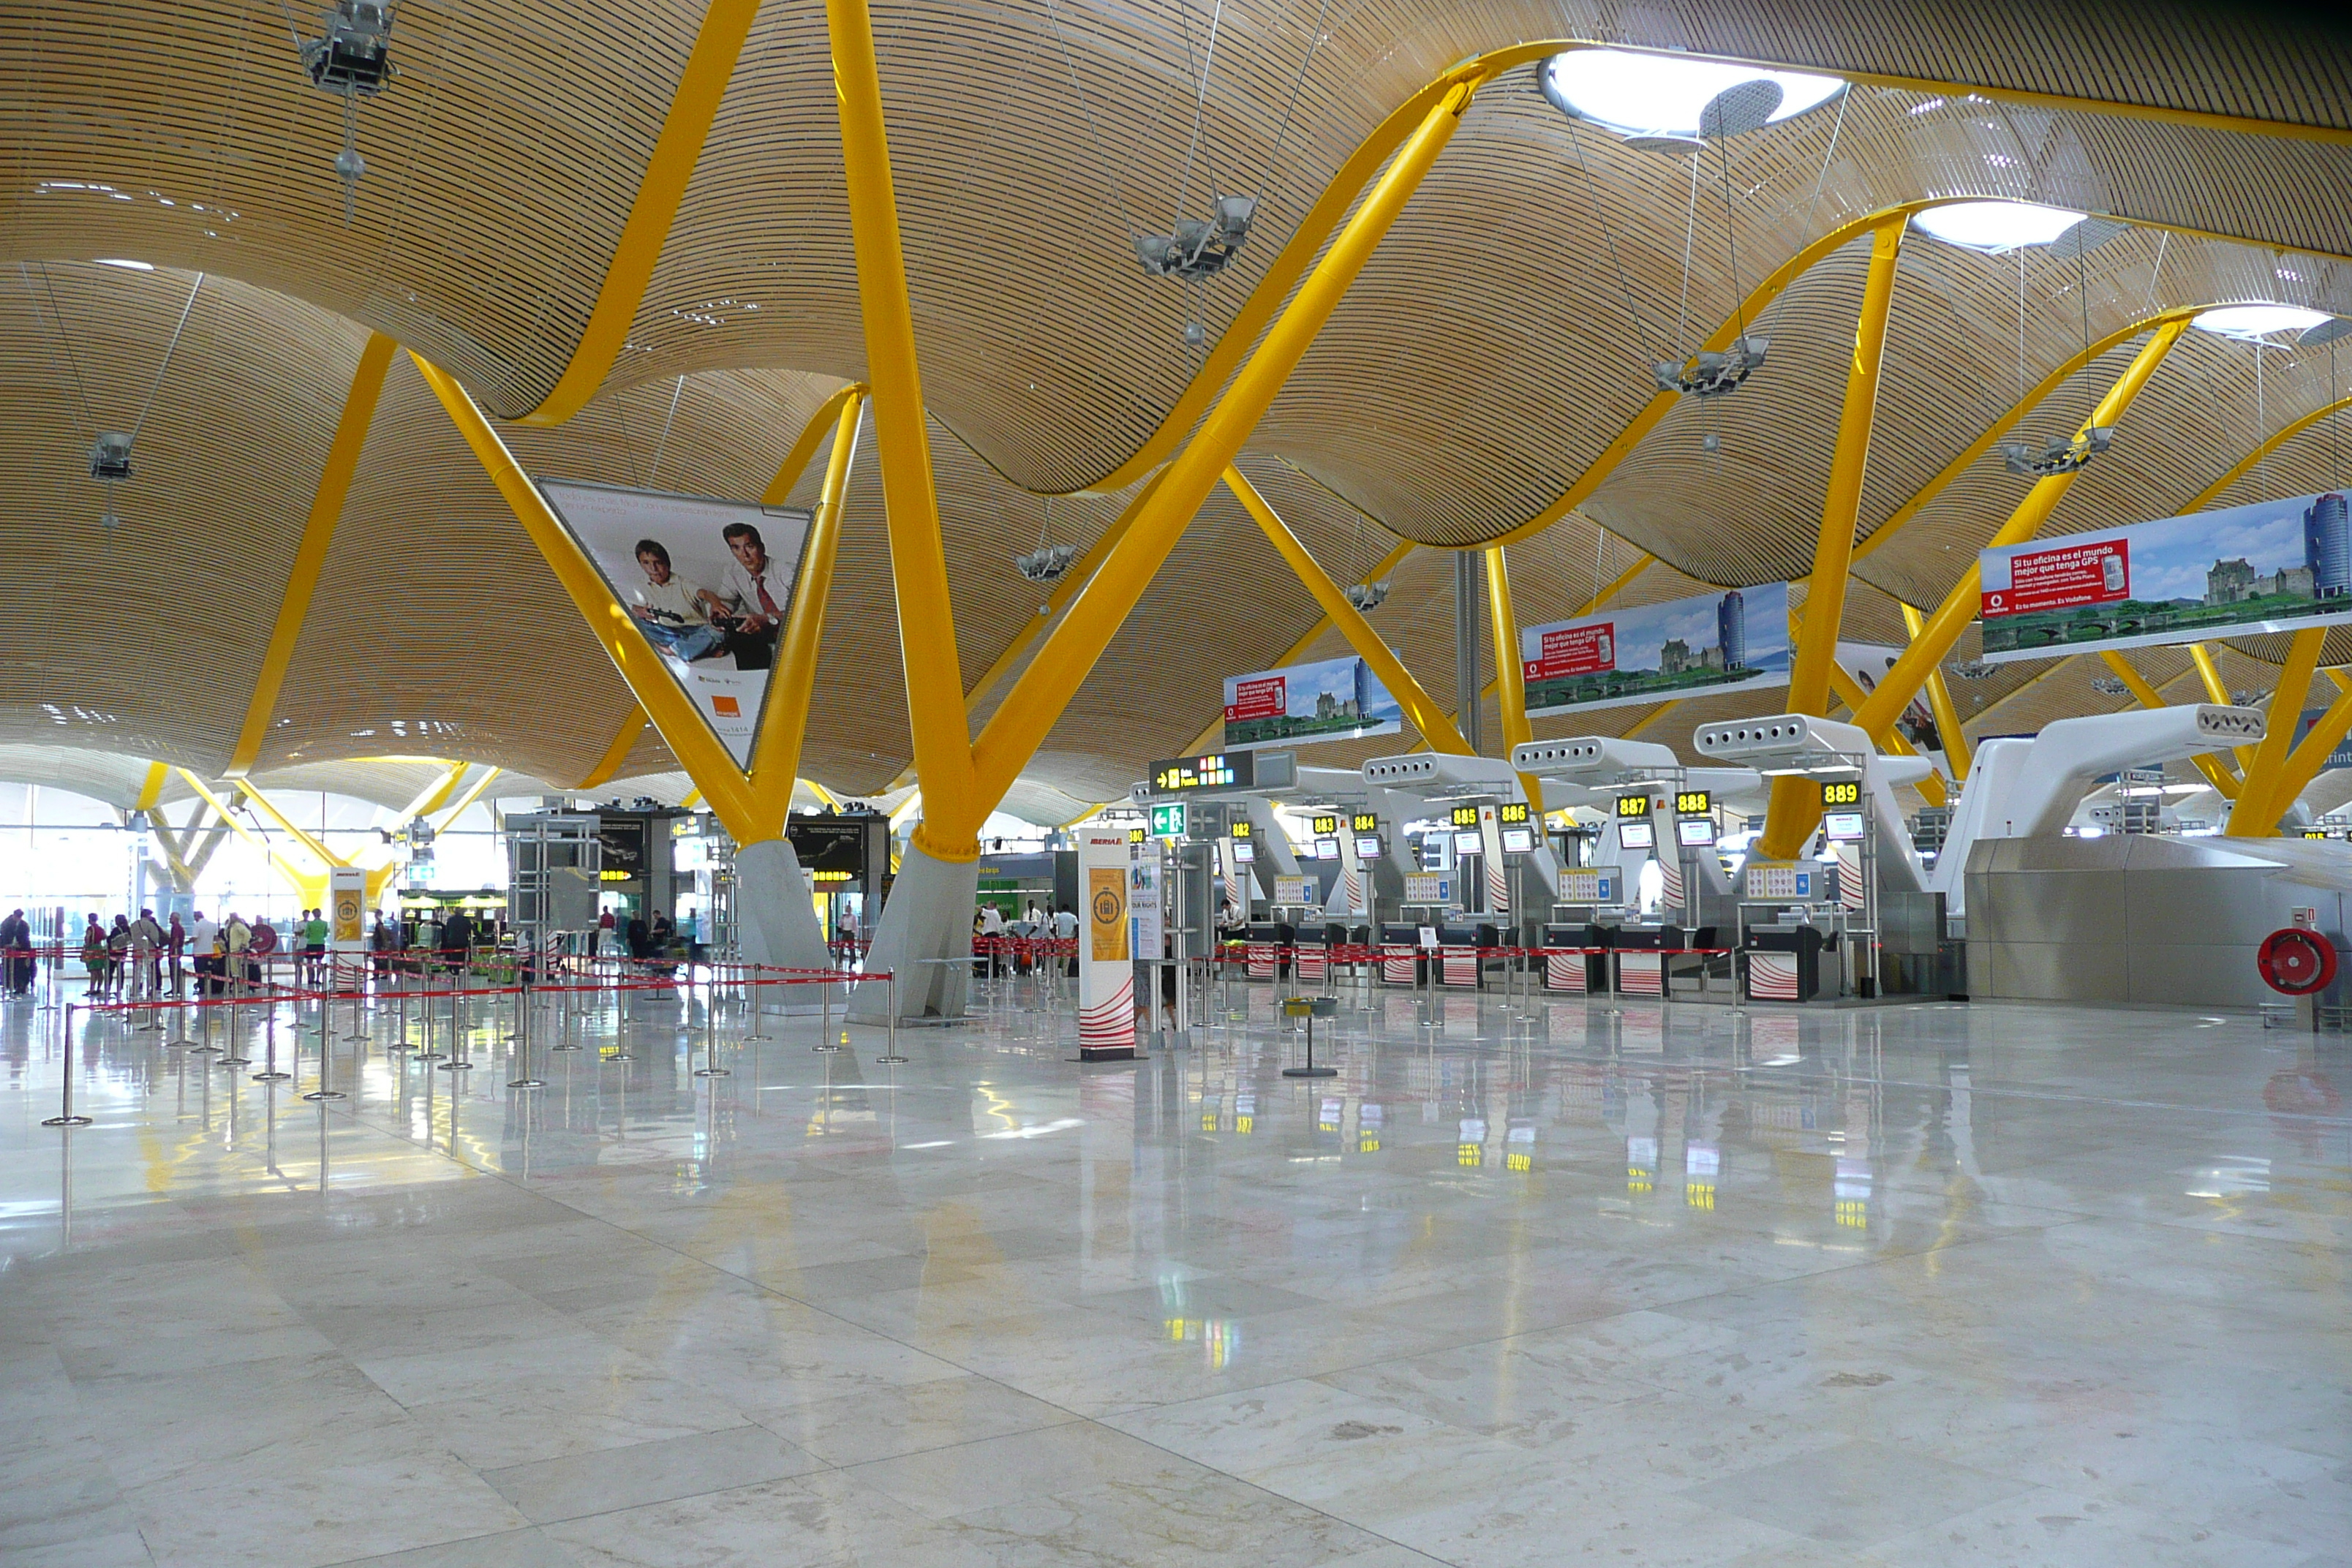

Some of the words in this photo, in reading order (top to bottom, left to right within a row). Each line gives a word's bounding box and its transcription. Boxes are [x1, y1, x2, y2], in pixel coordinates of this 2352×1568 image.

[2014, 559, 2021, 568] Si
[2033, 554, 2060, 565] oficina
[2073, 549, 2081, 559] el
[2083, 546, 2113, 557] mundo
[2015, 566, 2038, 576] mejor
[2040, 565, 2054, 573] que
[2057, 560, 2080, 570] tenga
[2081, 556, 2098, 566] GPS
[1985, 606, 2009, 614] vodafone
[1825, 784, 1857, 803] 889
[1620, 798, 1646, 815] 887
[1678, 794, 1707, 812] 888
[1454, 809, 1476, 825] 885
[1502, 804, 1526, 821] 886
[1233, 823, 1249, 837] 882
[1315, 818, 1334, 833] 883
[1354, 815, 1375, 831] 884
